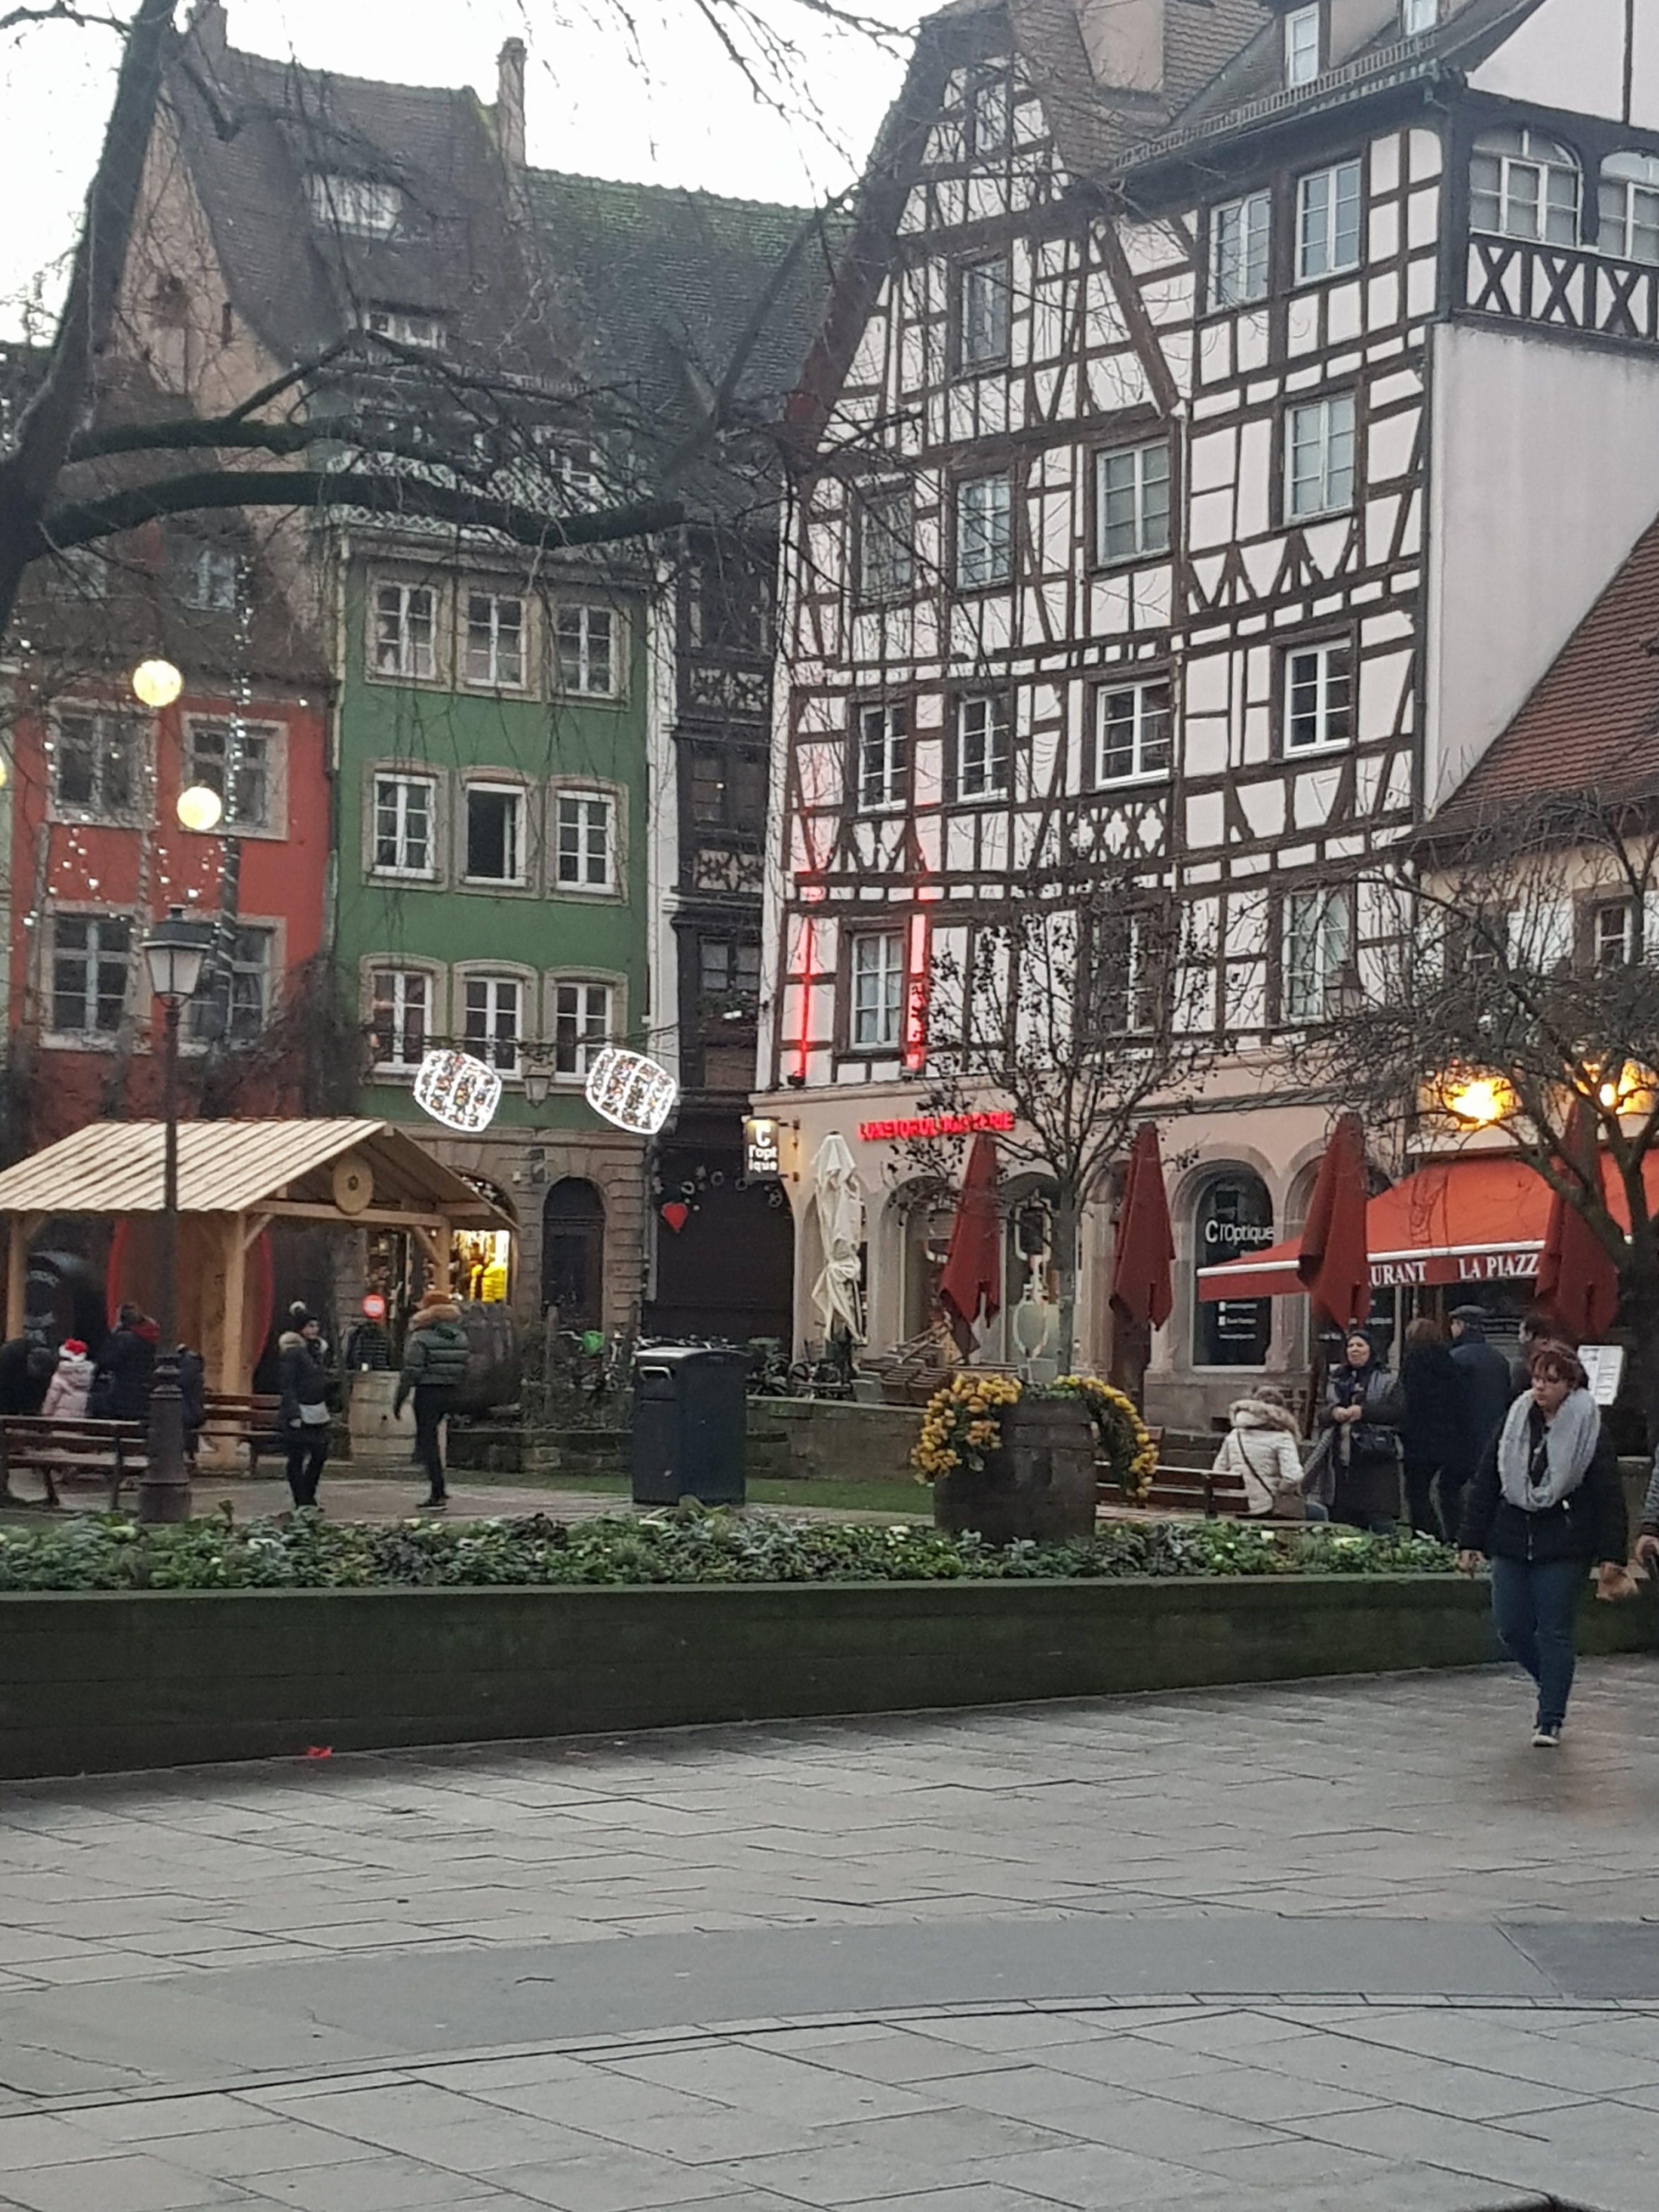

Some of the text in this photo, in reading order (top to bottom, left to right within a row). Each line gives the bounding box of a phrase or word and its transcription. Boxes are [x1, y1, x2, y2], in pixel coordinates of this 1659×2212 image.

[755, 1122, 771, 1147] C
[1368, 1252, 1540, 1286] URANT LA PIAZZ
